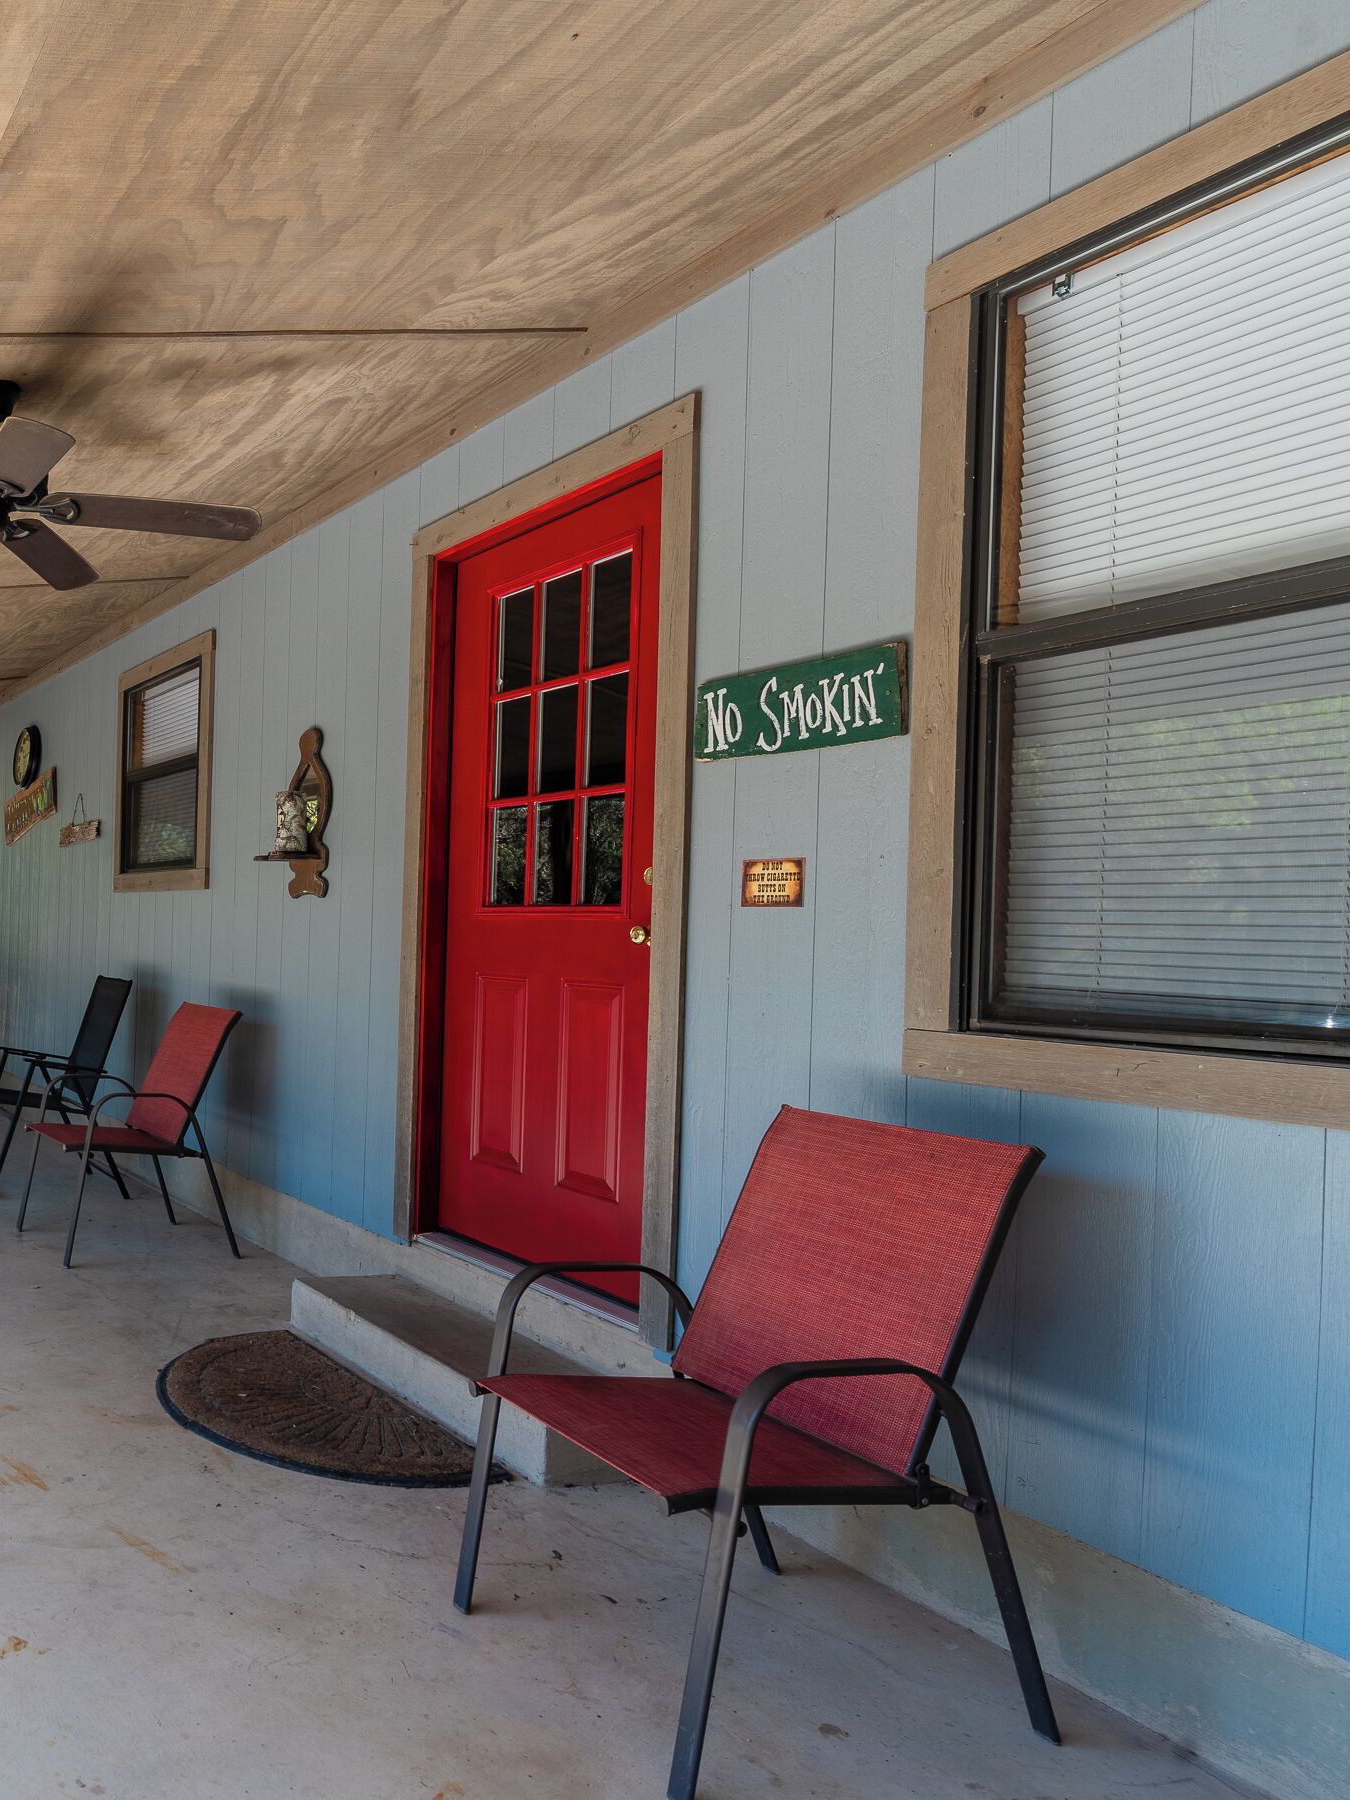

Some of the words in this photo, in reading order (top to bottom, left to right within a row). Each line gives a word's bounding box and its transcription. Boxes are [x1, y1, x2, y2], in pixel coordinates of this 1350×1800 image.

[703, 687, 743, 753] NO
[762, 862, 769, 870] DO
[771, 861, 783, 870] NOT
[745, 873, 766, 882] THROW
[766, 872, 801, 882] CIGARETTE
[757, 884, 777, 893] BUTTS
[778, 884, 786, 892] ON
[753, 895, 765, 904] THE
